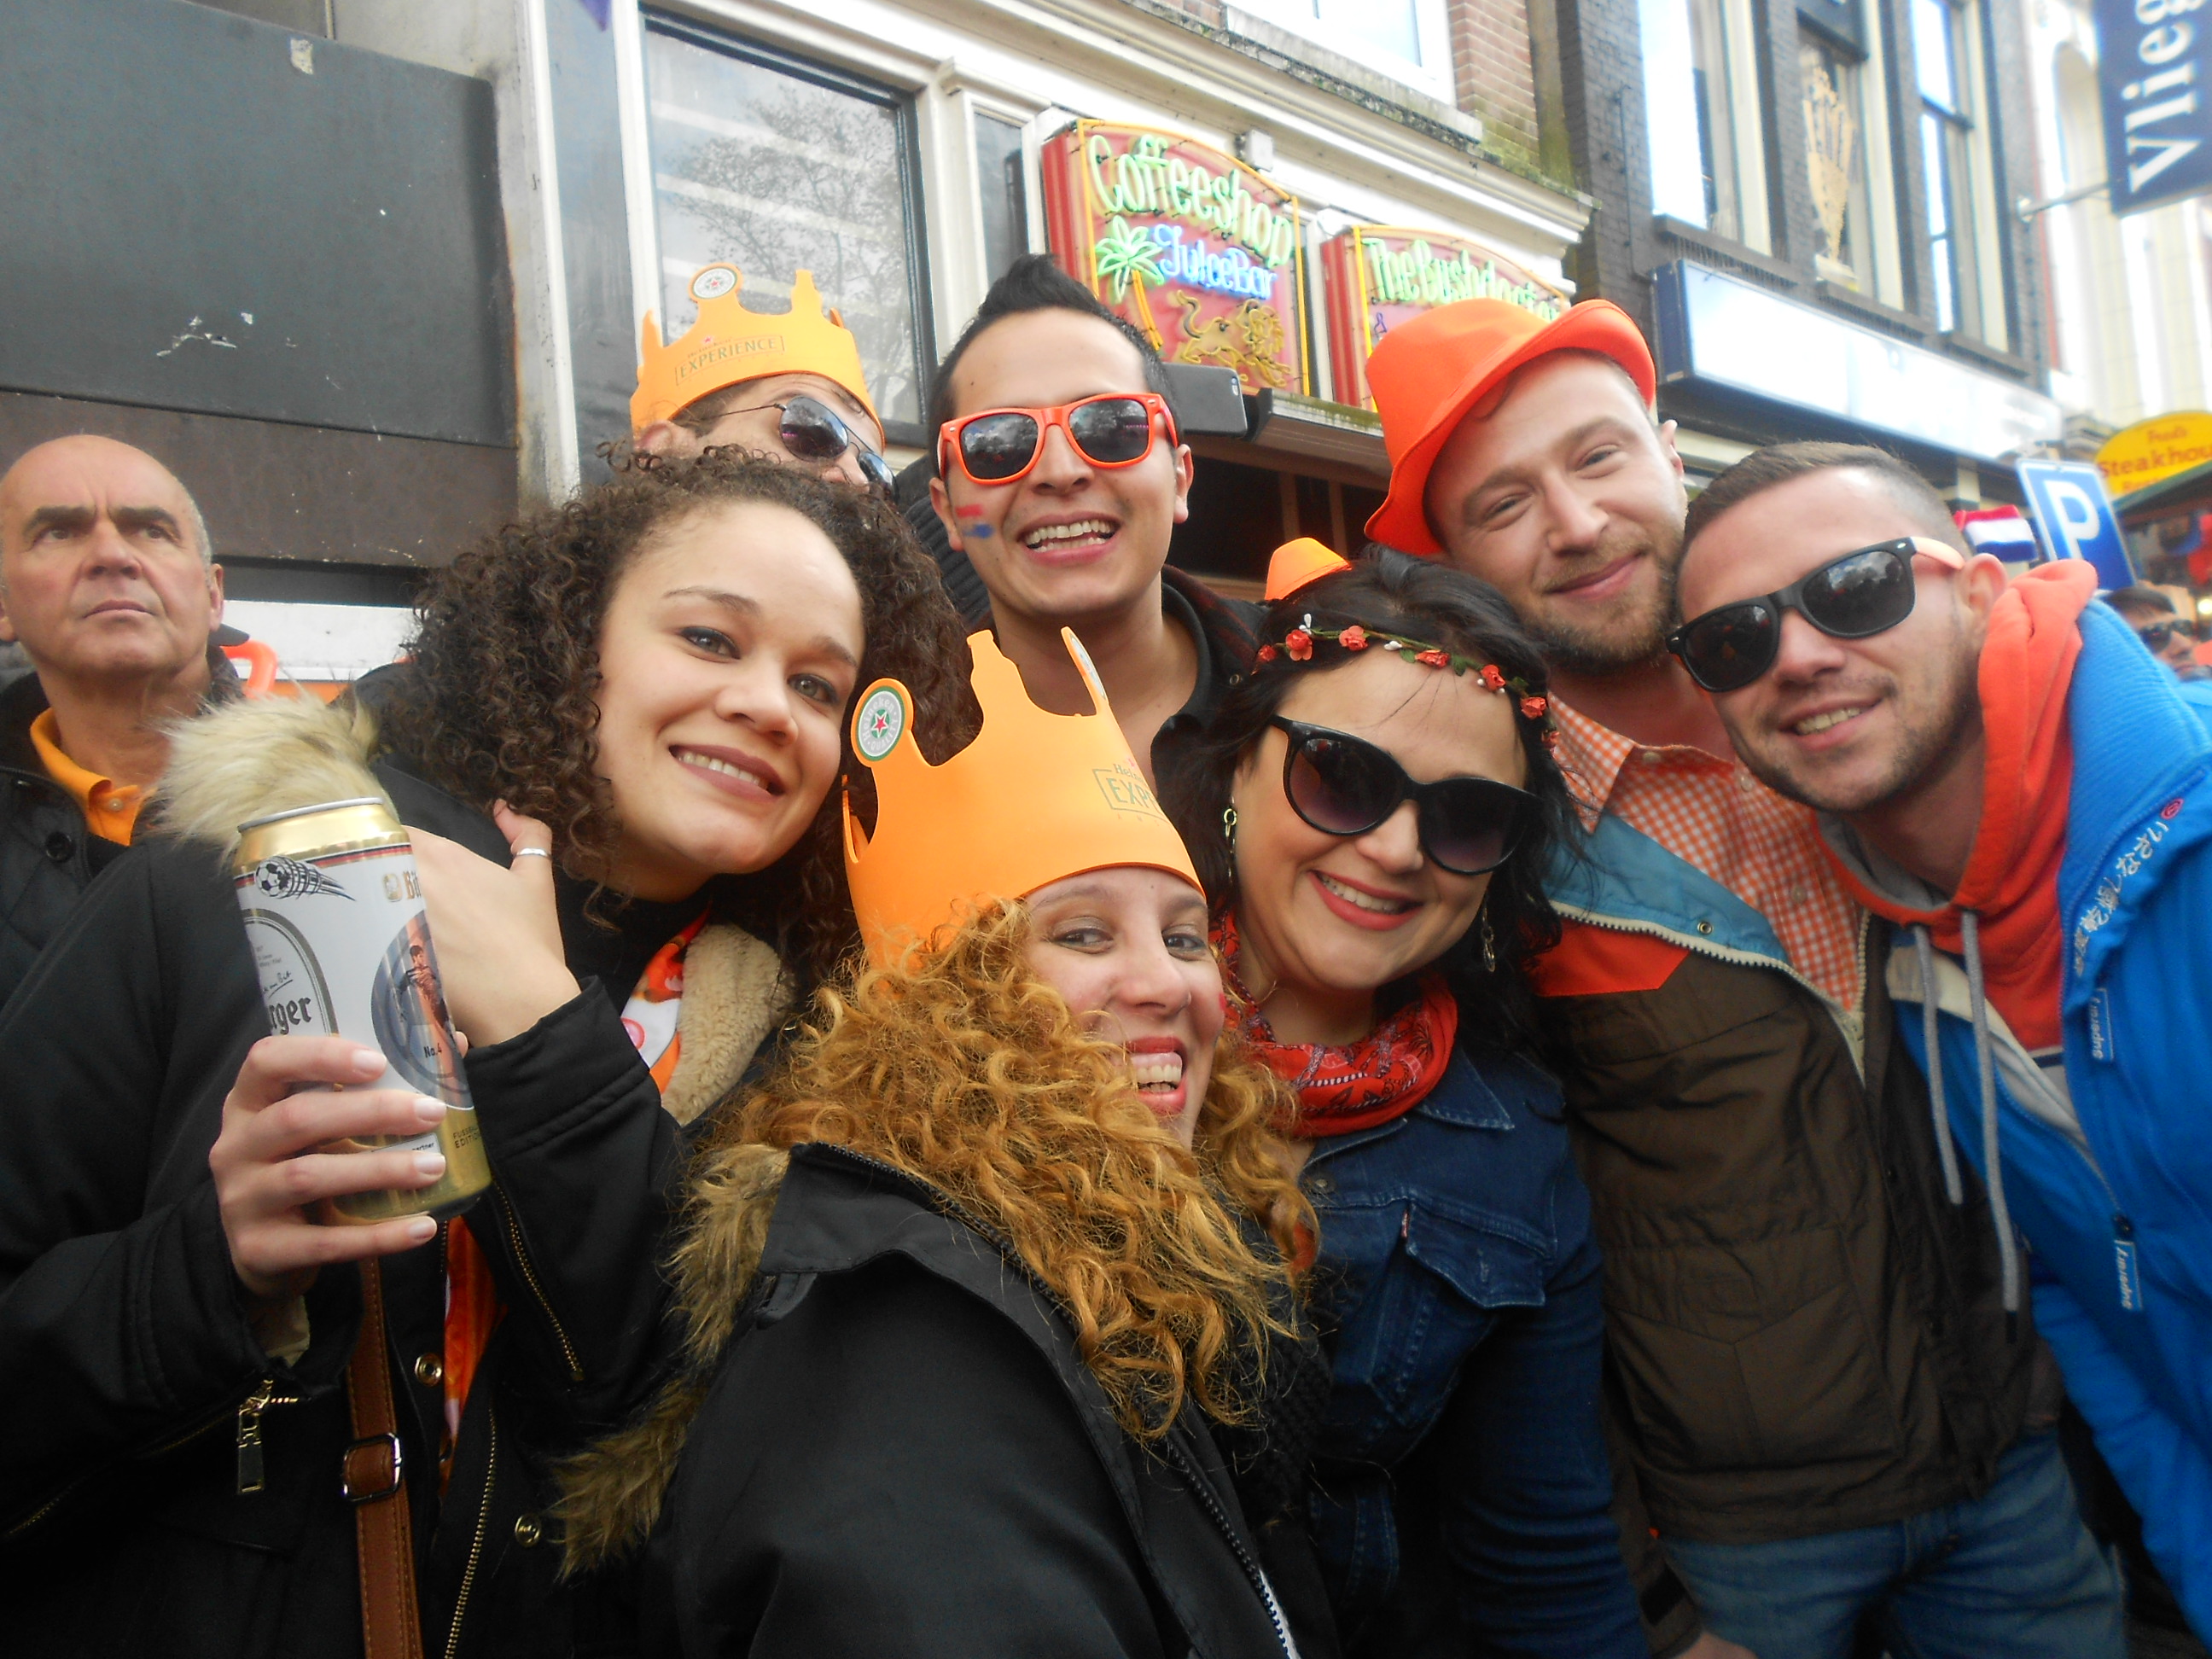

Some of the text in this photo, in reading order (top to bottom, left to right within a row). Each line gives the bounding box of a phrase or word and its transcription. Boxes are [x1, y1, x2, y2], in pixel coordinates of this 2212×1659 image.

[1089, 134, 1294, 269] Coffeeshop
[680, 338, 776, 378] EXPERIENCE
[2044, 480, 2099, 563] P
